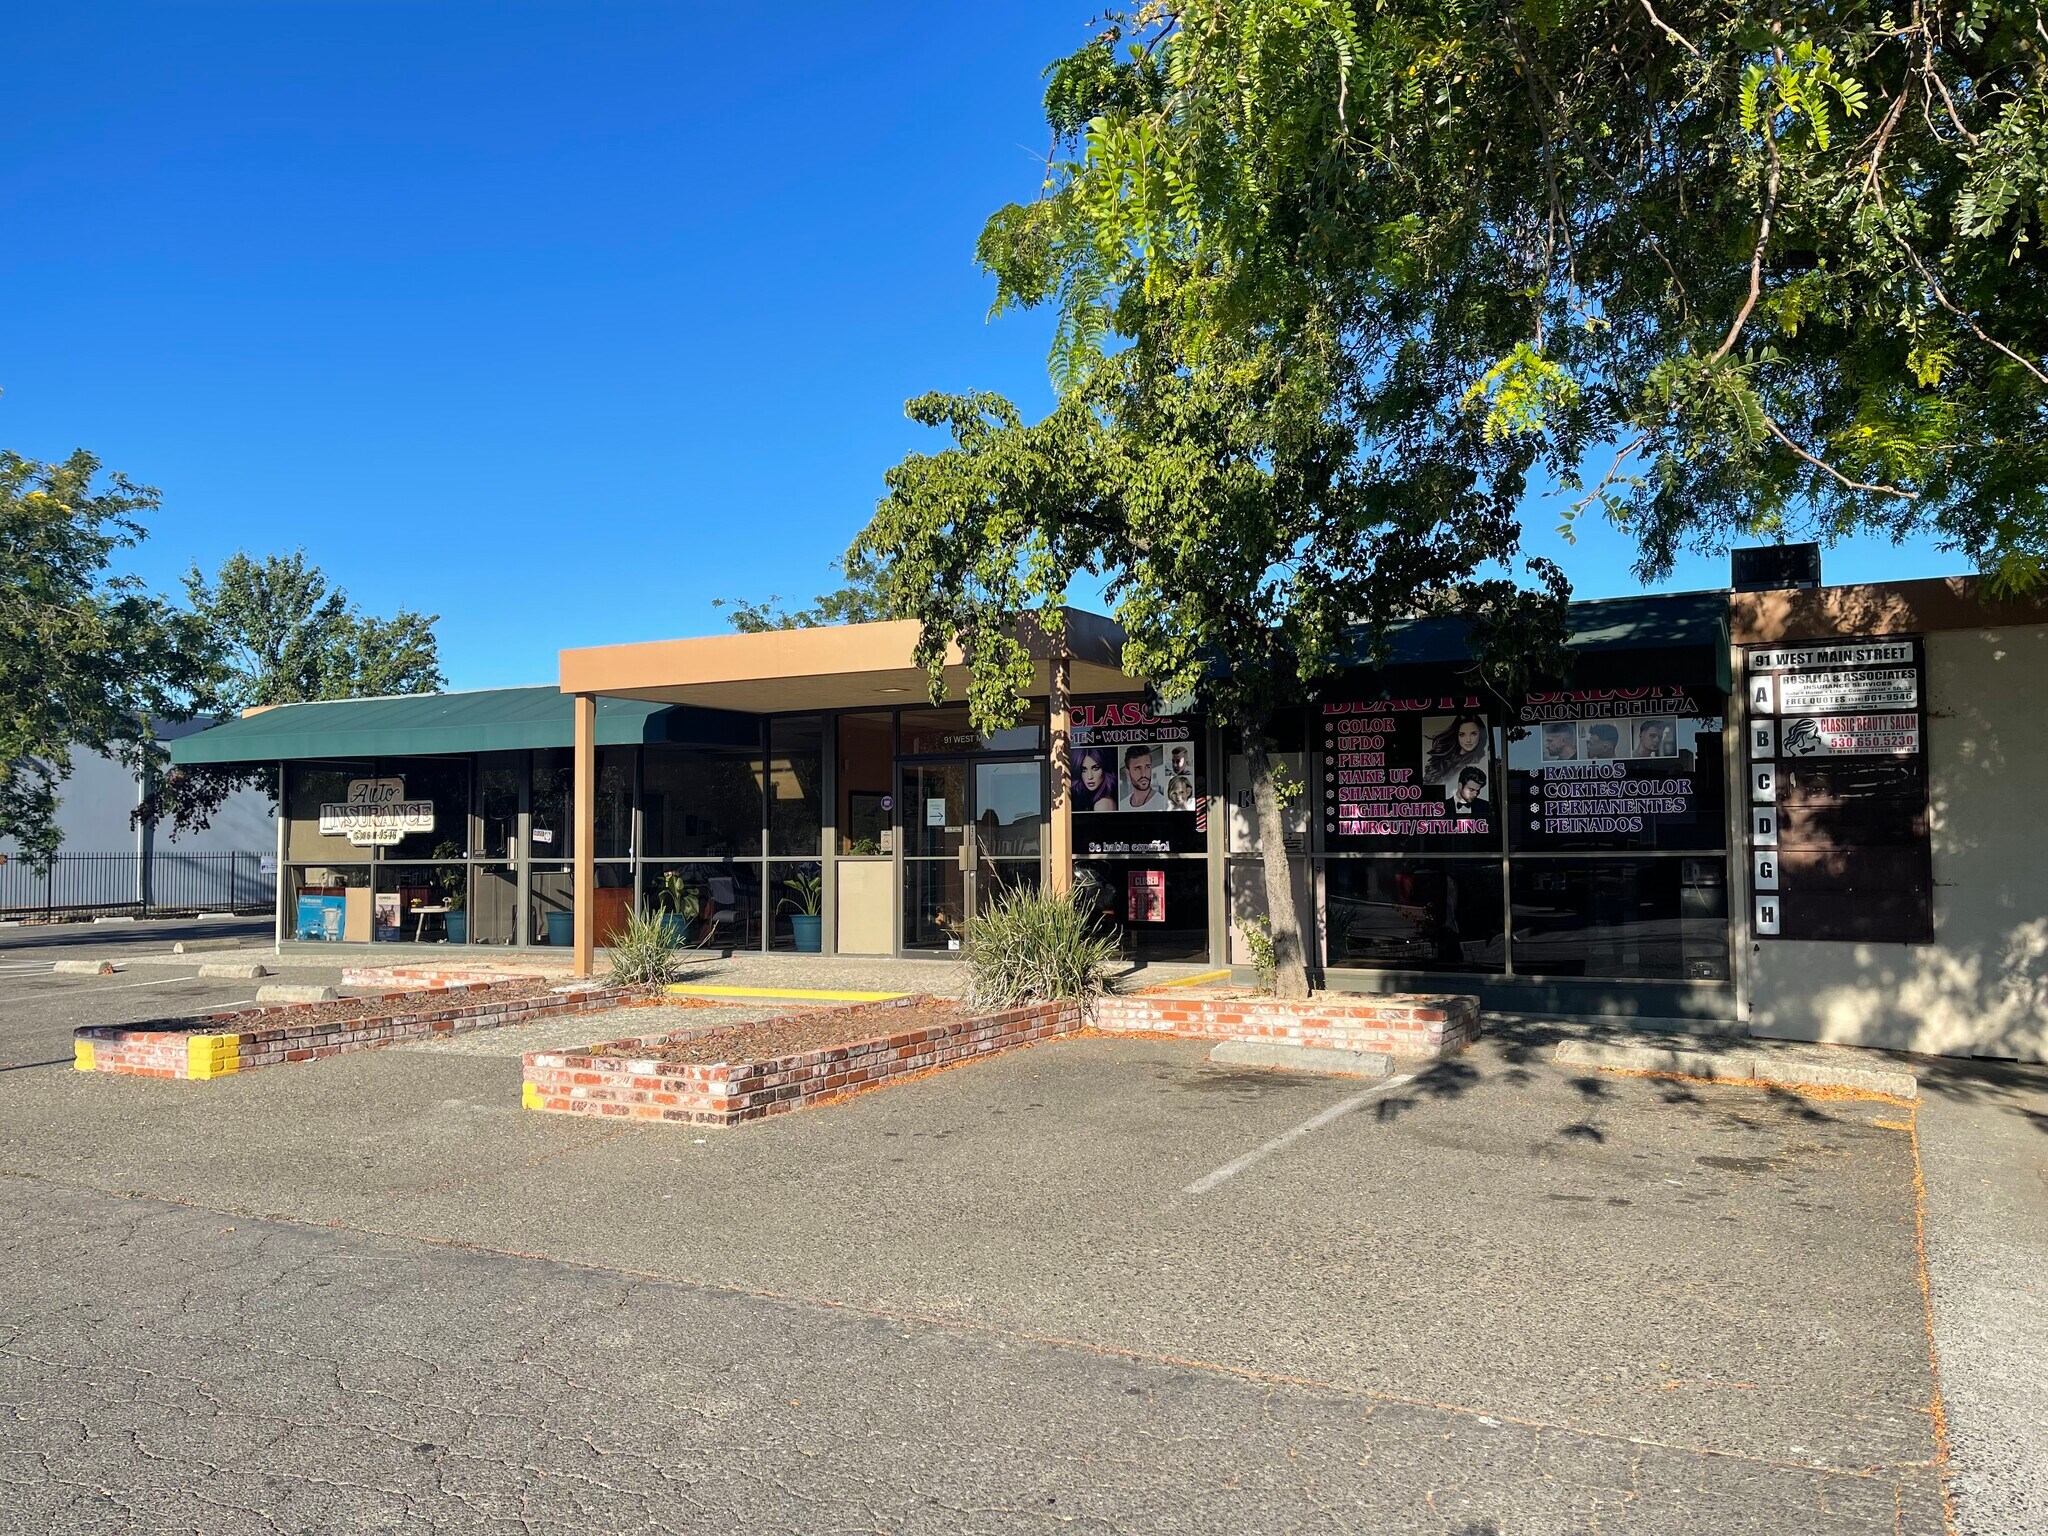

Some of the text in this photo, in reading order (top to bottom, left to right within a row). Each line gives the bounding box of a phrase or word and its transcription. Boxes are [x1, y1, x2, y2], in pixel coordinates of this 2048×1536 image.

[1755, 647, 1907, 667] 91 WEST MAIN STREET
[1783, 669, 1916, 685] ROSALIA & ASSOCIATES
[1803, 680, 1893, 690] INSURANCE SERVICES
[1755, 686, 1768, 703] A
[1786, 698, 1807, 706] FREE
[1809, 695, 1846, 704] QUOTES
[1521, 697, 1699, 721] SALON DE BELLEZA
[1338, 718, 1396, 734] COLOR
[1820, 715, 1917, 733] CLASSIC BEAUTY SALON
[943, 735, 953, 744] 91
[953, 735, 975, 743] WEST
[1102, 729, 1149, 743] WOMEN
[1157, 726, 1190, 740] KIDS
[1338, 735, 1385, 750] UPDO
[1756, 730, 1769, 747] B
[1831, 735, 1914, 748] 530.650.5230
[1338, 752, 1385, 767] PERM
[1339, 768, 1413, 784] MAKE UP
[1544, 763, 1627, 780] RAYITOS
[1544, 779, 1693, 798] CORTES/COLOR
[1757, 773, 1771, 790] C
[350, 783, 400, 803] Auto
[1339, 785, 1422, 801] SHAMPOO
[1339, 802, 1445, 818] HIGHLIGHTS
[1544, 797, 1687, 816] PERMANENTES
[322, 803, 433, 830] INSURANCE
[1339, 819, 1489, 835] HAIRCUT/STYLING
[1545, 817, 1644, 833] PEINADOS
[1758, 817, 1771, 834] D
[1088, 840, 1170, 853] Se habla español
[1760, 862, 1772, 879] G
[1134, 876, 1159, 886] CLOSED
[1761, 906, 1774, 923] H
